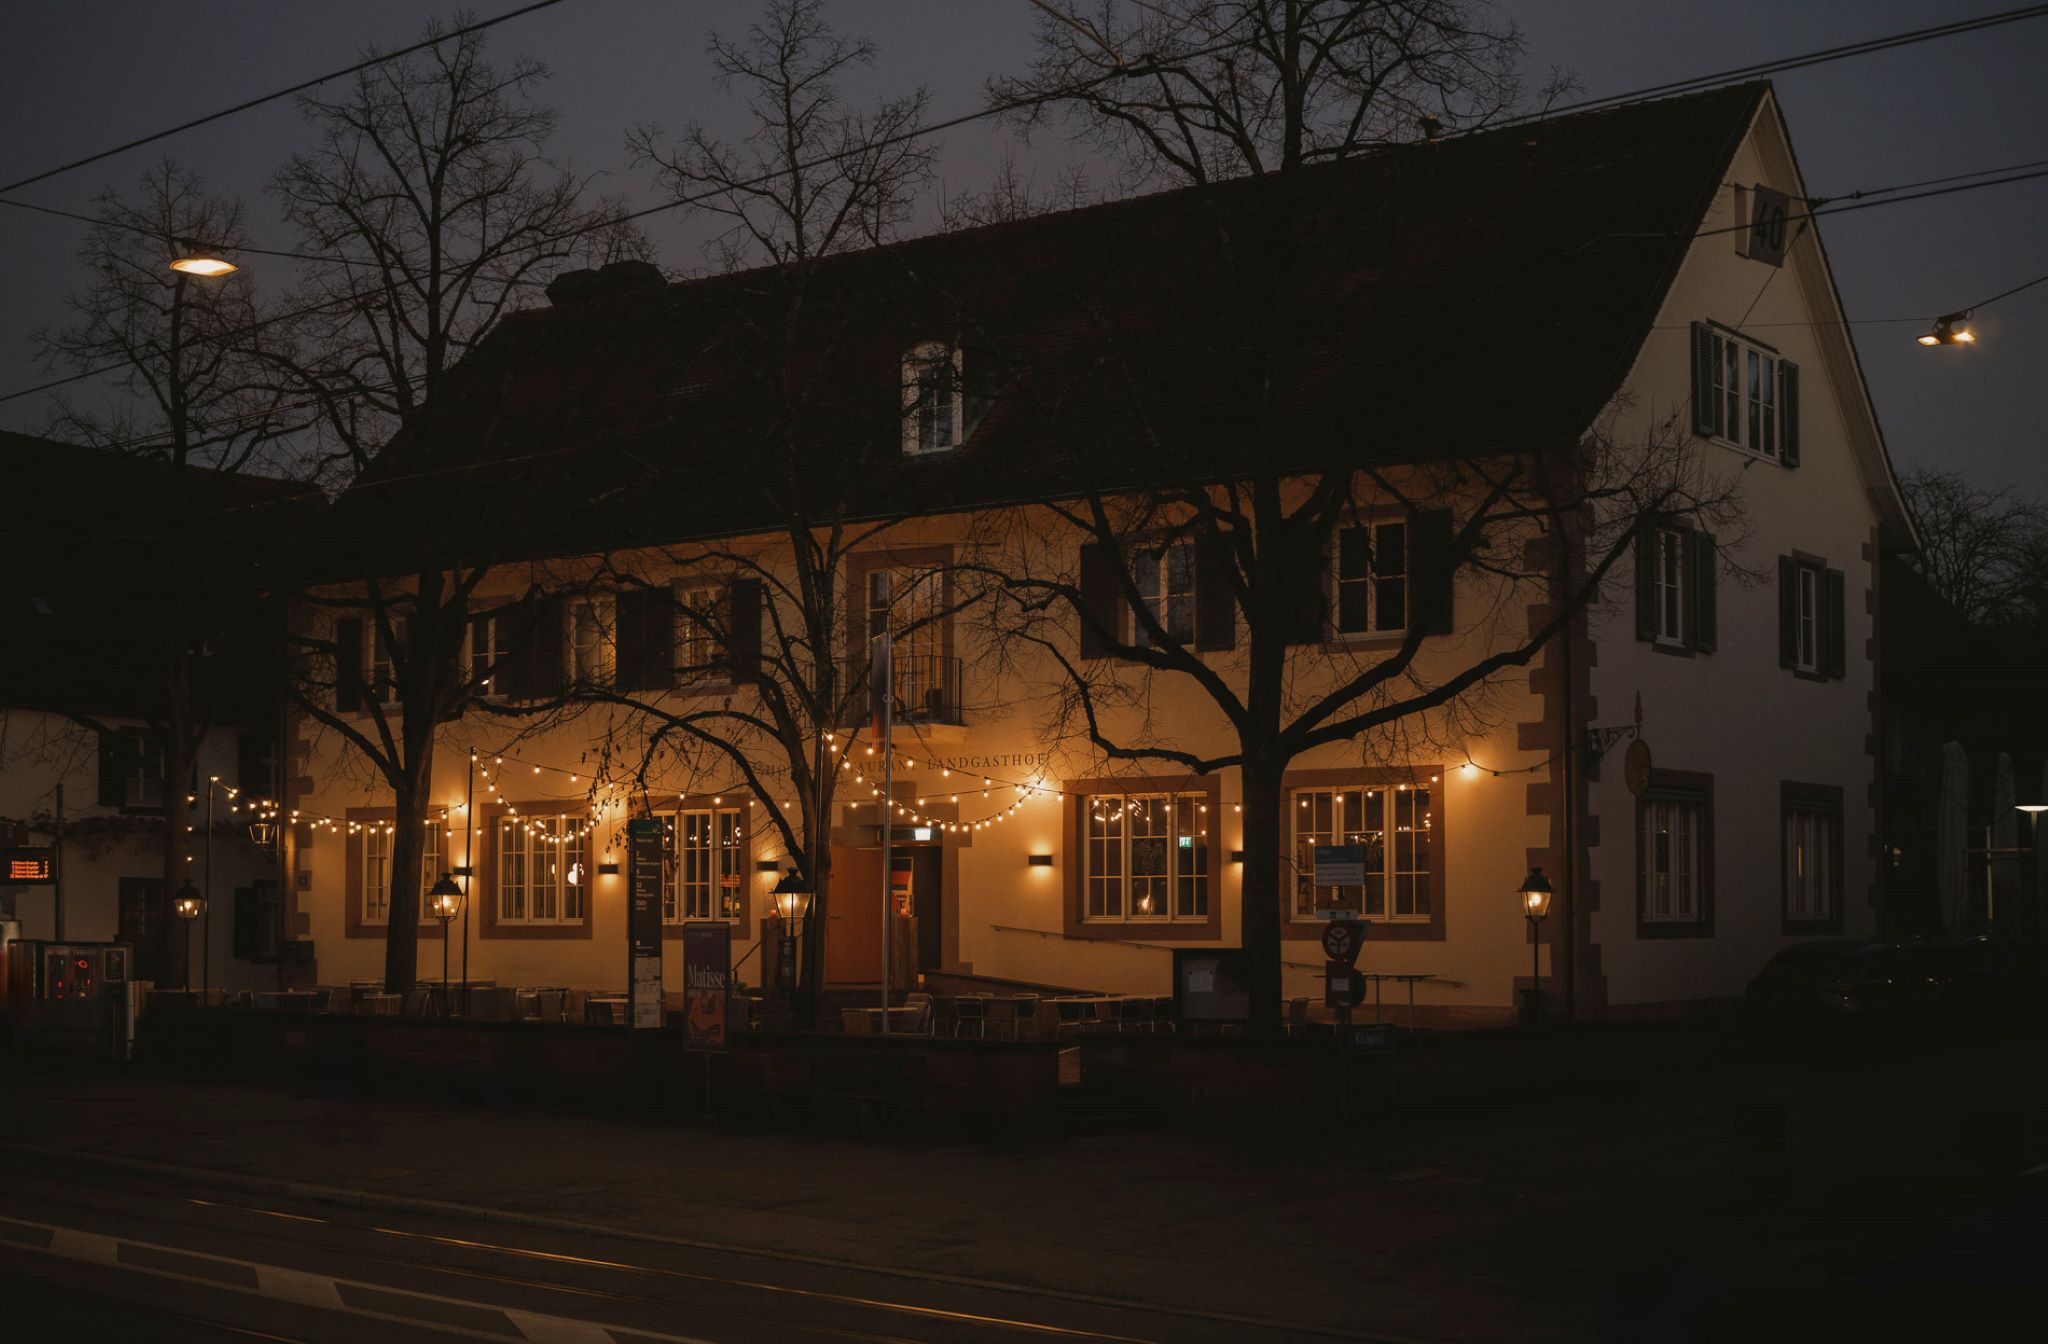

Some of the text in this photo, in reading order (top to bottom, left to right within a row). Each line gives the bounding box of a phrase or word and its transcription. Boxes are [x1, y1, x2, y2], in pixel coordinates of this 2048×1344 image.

[1756, 203, 1784, 250] 40
[927, 752, 1048, 770] LANDGASTHOF
[688, 964, 726, 989] Matisse
